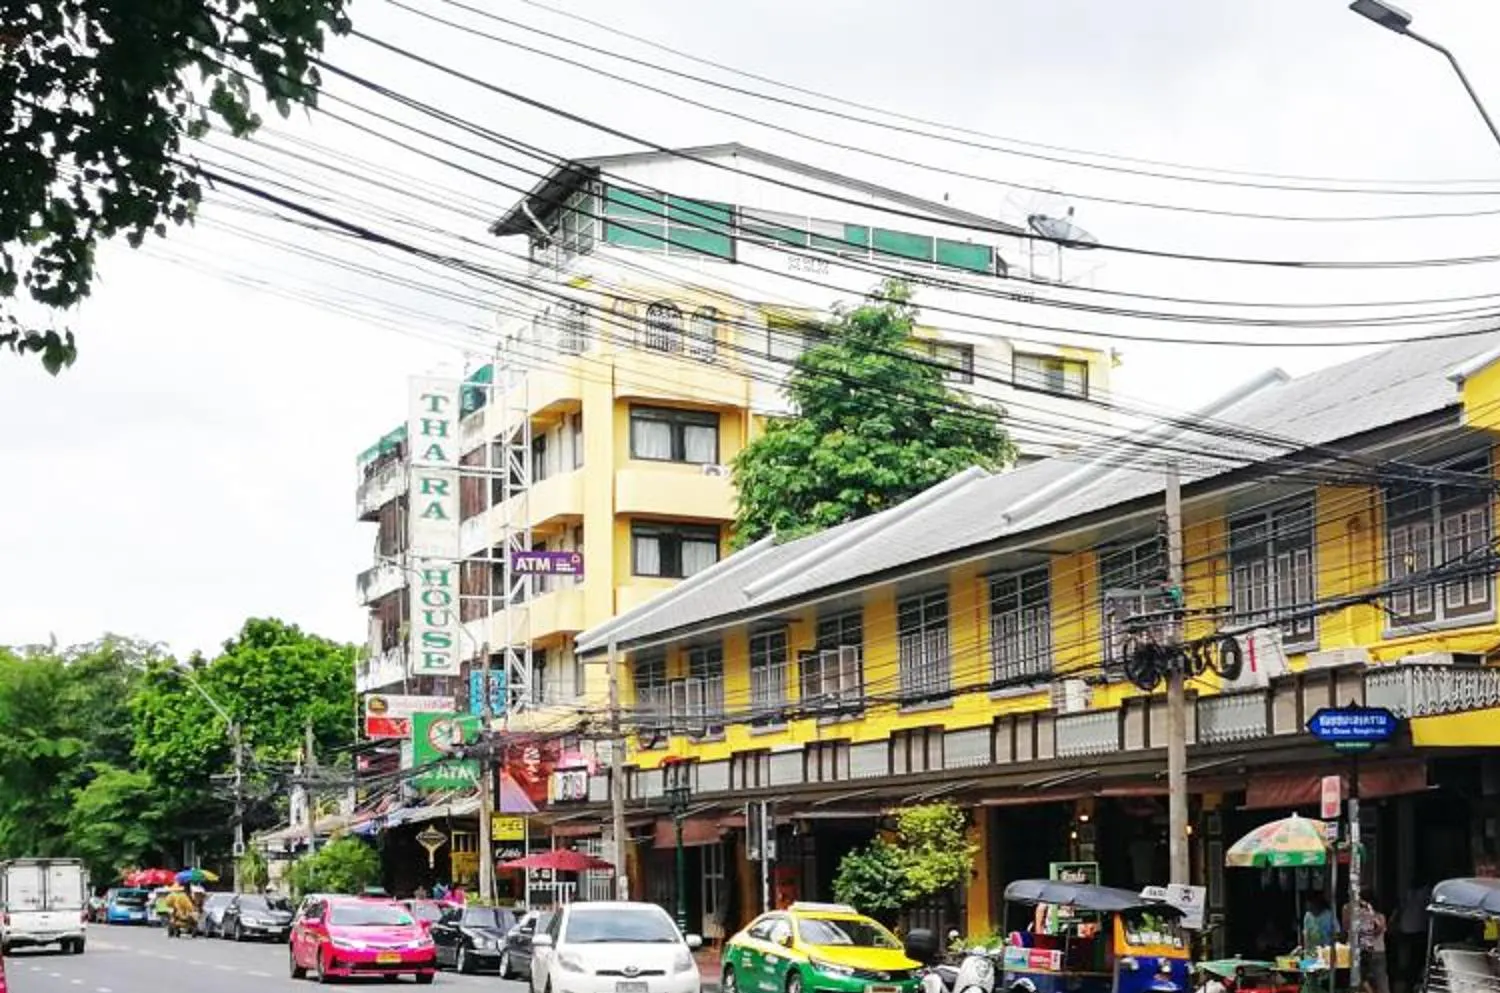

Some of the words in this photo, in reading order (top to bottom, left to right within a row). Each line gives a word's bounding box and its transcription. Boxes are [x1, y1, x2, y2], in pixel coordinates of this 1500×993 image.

[420, 394, 450, 521] THARA
[515, 557, 550, 571] ATM
[421, 568, 453, 670] HOUSE
